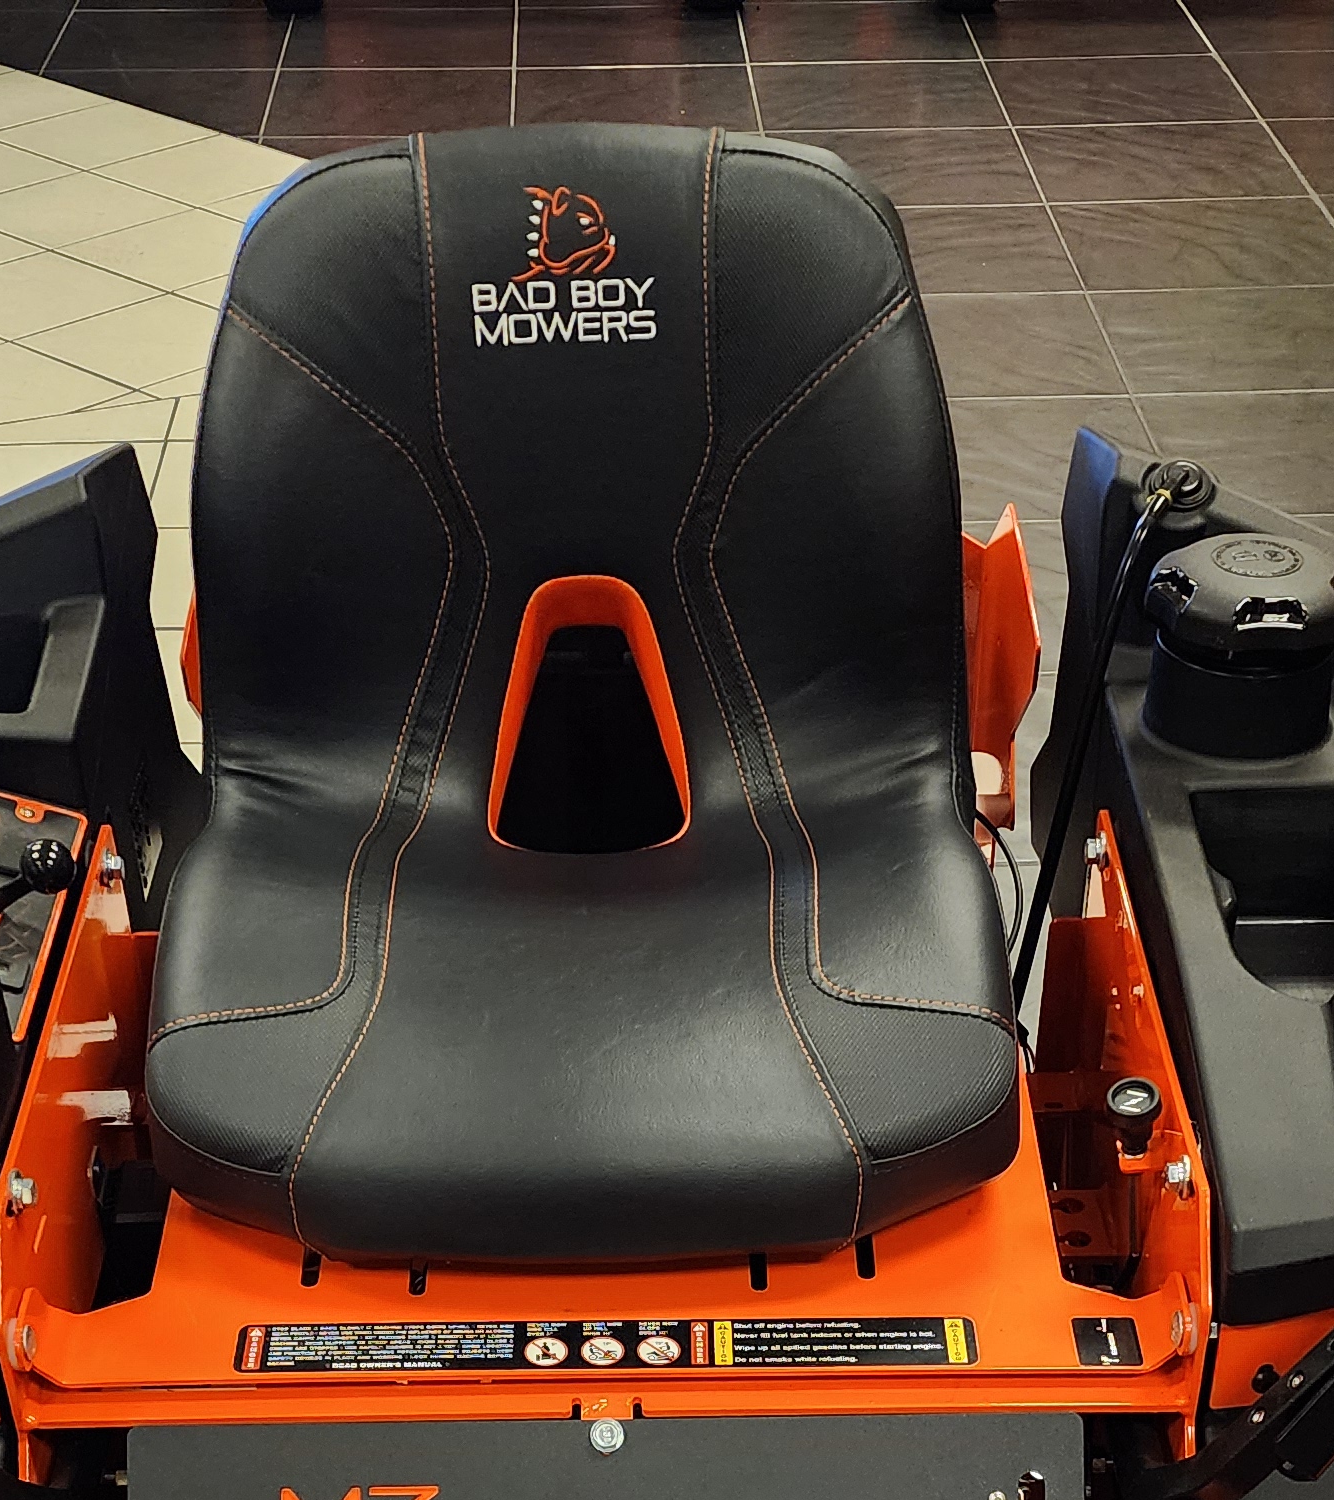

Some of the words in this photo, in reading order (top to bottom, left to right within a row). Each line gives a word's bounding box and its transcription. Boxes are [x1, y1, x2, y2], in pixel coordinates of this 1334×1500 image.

[471, 280, 556, 313] BAD
[571, 276, 655, 309] BOY
[473, 310, 657, 347] MOWERS
